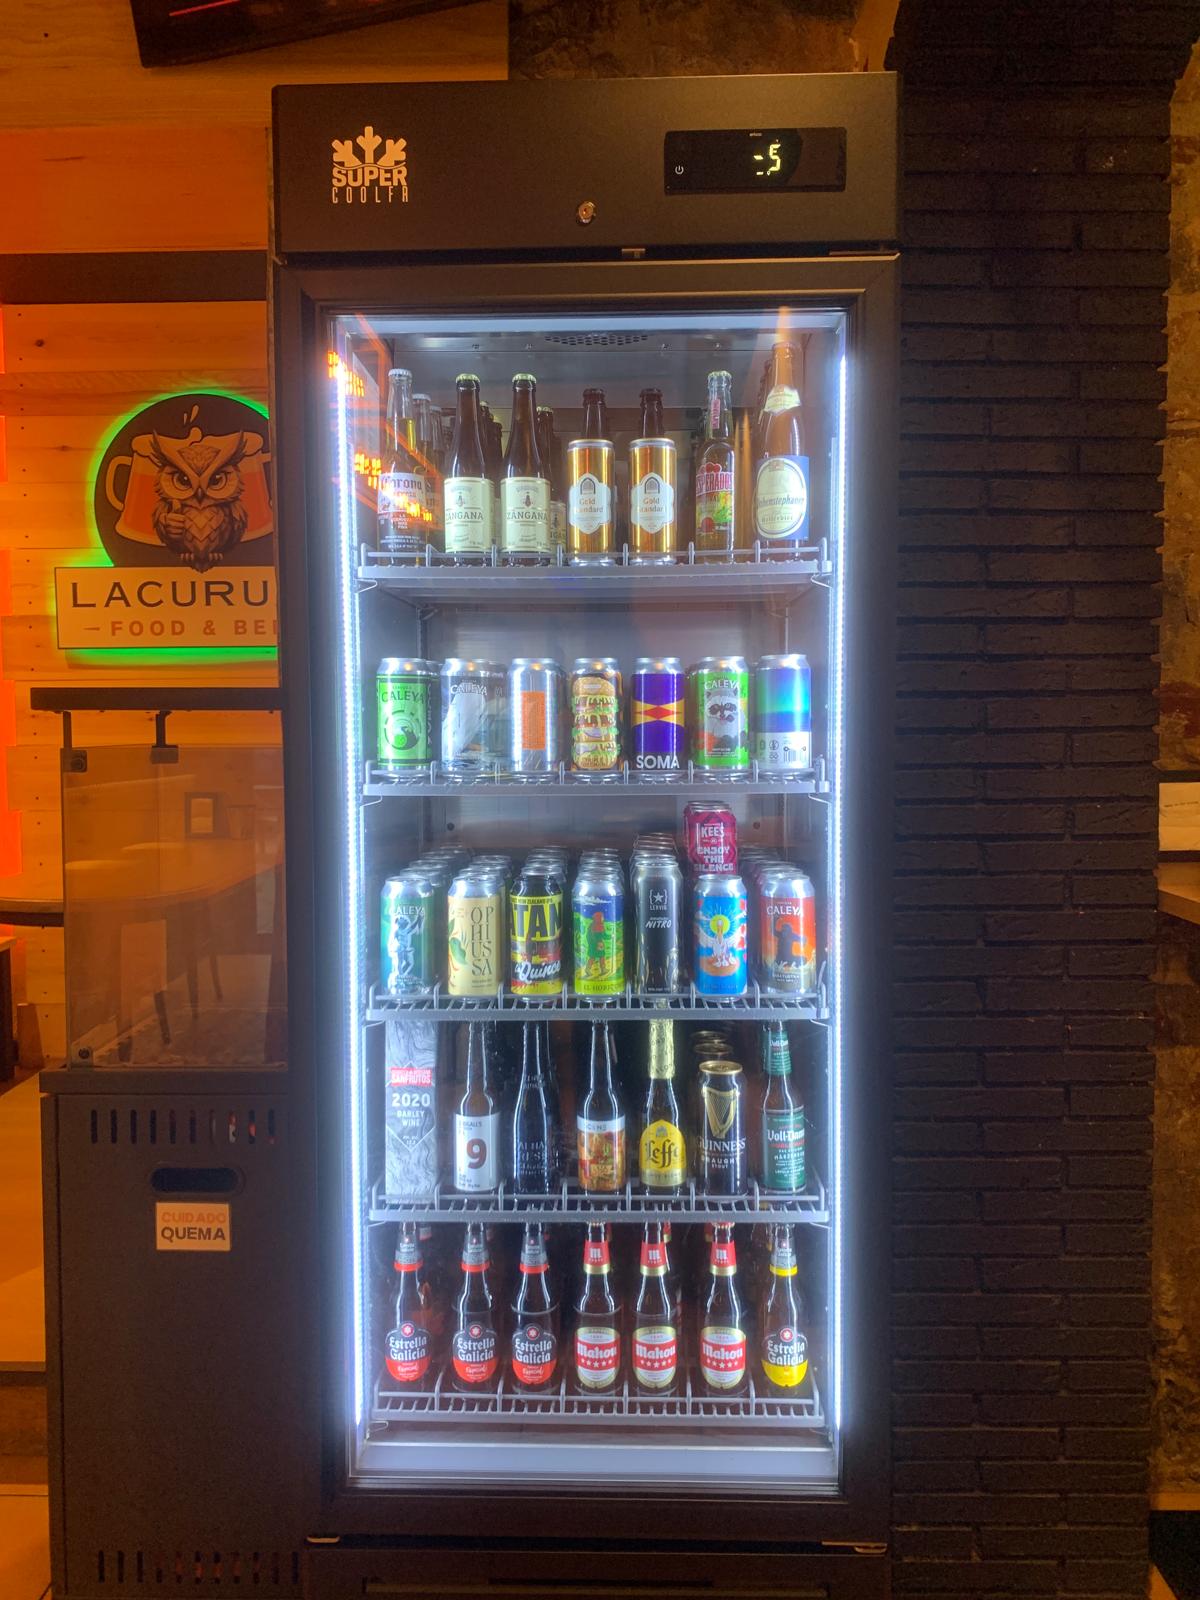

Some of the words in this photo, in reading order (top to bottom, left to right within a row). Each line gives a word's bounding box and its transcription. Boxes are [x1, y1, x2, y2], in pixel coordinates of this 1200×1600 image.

[332, 166, 408, 187] SUPER
[71, 580, 269, 608] LACURU
[110, 620, 186, 637] FOOD
[203, 620, 216, 636] &
[635, 754, 681, 770] SOMA
[392, 905, 425, 916] ALEYA
[391, 1093, 431, 1107] 2020
[466, 1138, 487, 1169] 9
[161, 1211, 227, 1224] CUIDADO
[160, 1226, 226, 1243] QUEMA
[389, 1336, 427, 1350] Estrella
[456, 1336, 496, 1351] Estrella
[514, 1338, 553, 1353] Estrella
[577, 1342, 617, 1359] Mahou
[767, 1340, 805, 1354] Estrella
[389, 1348, 426, 1361] Galicia
[457, 1349, 494, 1362] Galicia
[515, 1350, 551, 1364] Galicia
[635, 1343, 676, 1359] Mahou
[702, 1342, 743, 1360] Mahou
[768, 1351, 804, 1366] Galicia
